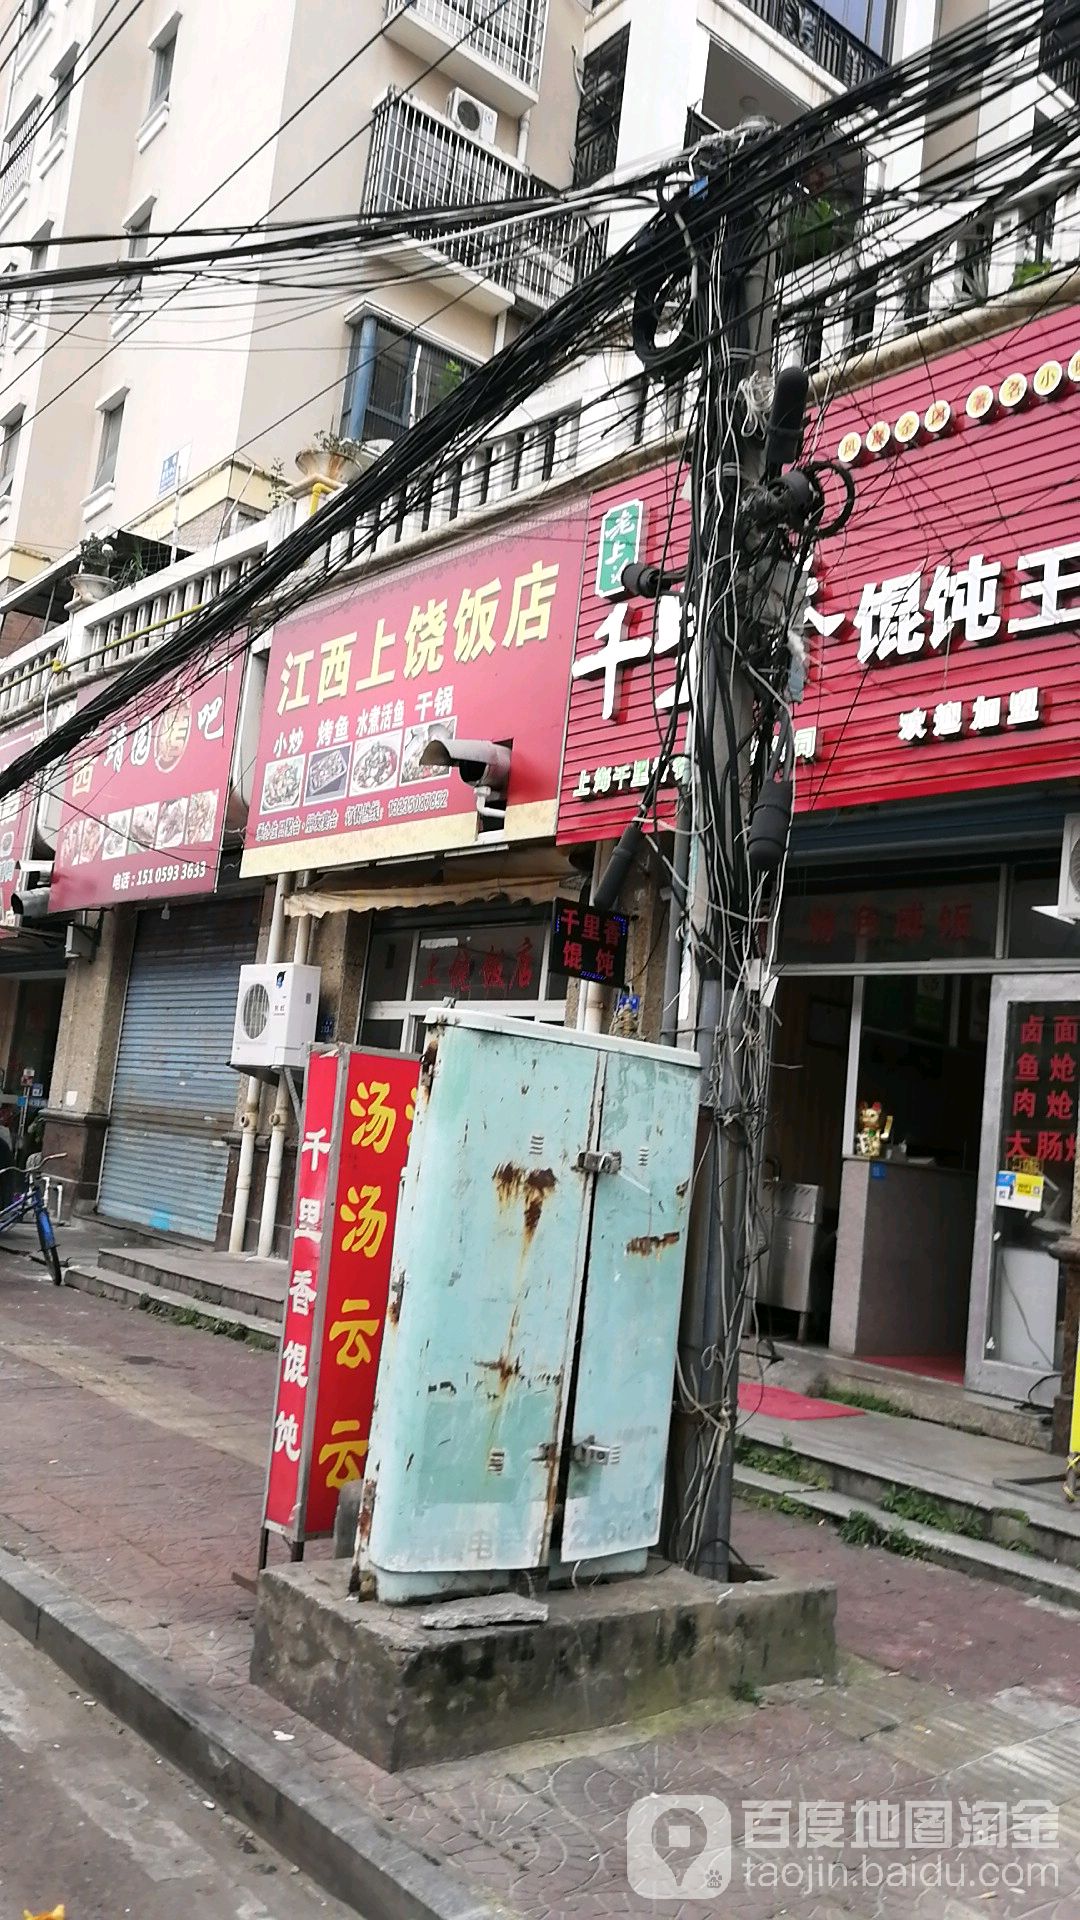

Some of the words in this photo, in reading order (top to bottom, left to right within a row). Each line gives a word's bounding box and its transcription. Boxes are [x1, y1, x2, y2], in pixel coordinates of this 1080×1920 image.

[277, 560, 560, 716] 江西上饶饭店
[274, 726, 304, 758] 小炒
[316, 714, 349, 748] 烤鱼
[356, 698, 405, 737] 水煮活鱼
[414, 685, 455, 722] 干锅
[897, 687, 1039, 740] 欢迎加盟
[1021, 1014, 1080, 1044] 卤面
[275, 1127, 331, 1462] 千里香馄饨
[318, 1080, 397, 1490] 汤汤云云
